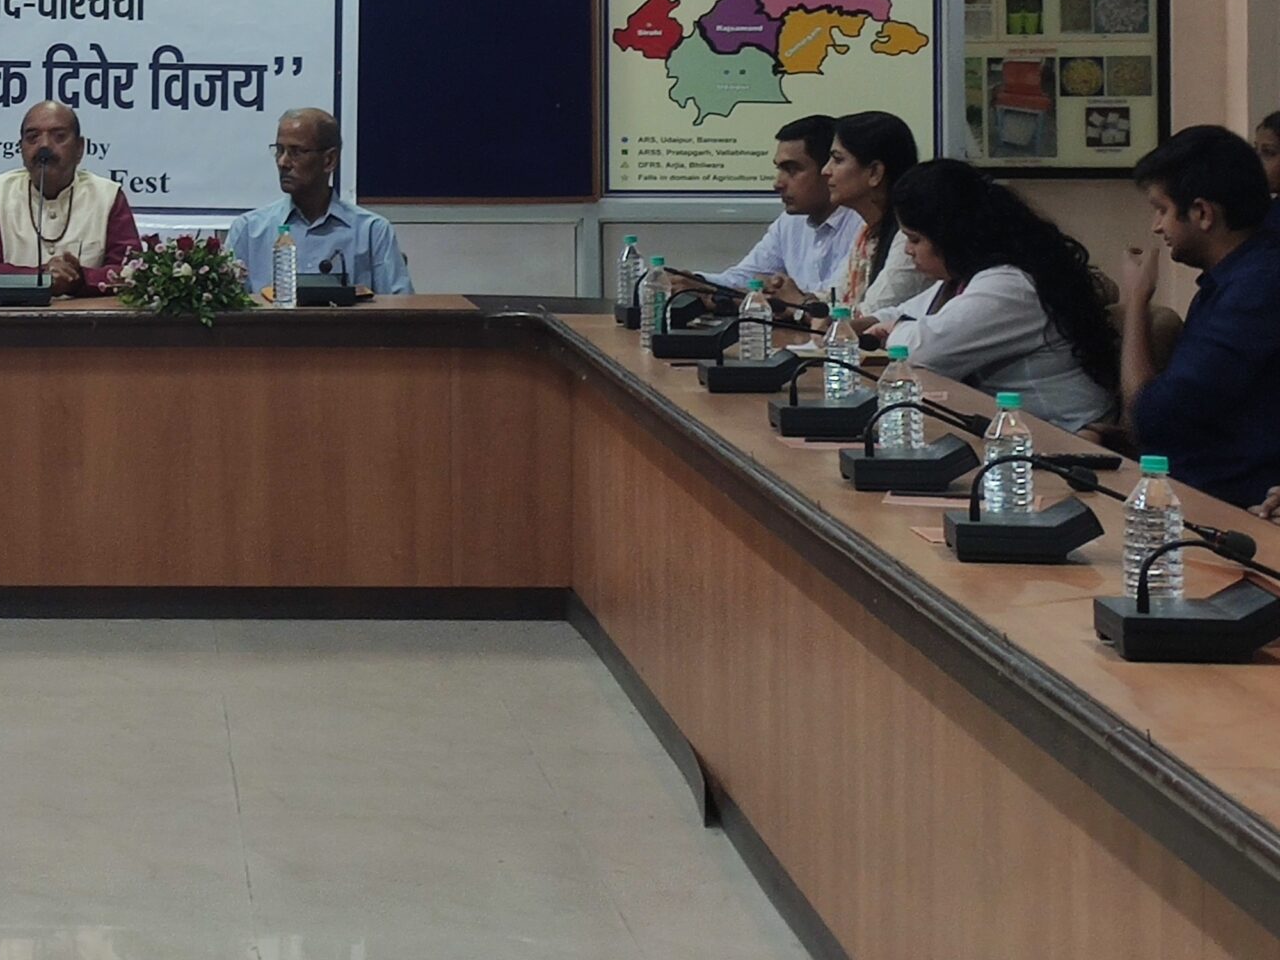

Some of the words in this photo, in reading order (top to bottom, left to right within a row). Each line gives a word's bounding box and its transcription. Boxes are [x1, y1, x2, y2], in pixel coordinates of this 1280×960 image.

[43, 42, 138, 111] दिवेर
[86, 138, 111, 160] by
[109, 169, 171, 193] Fest
